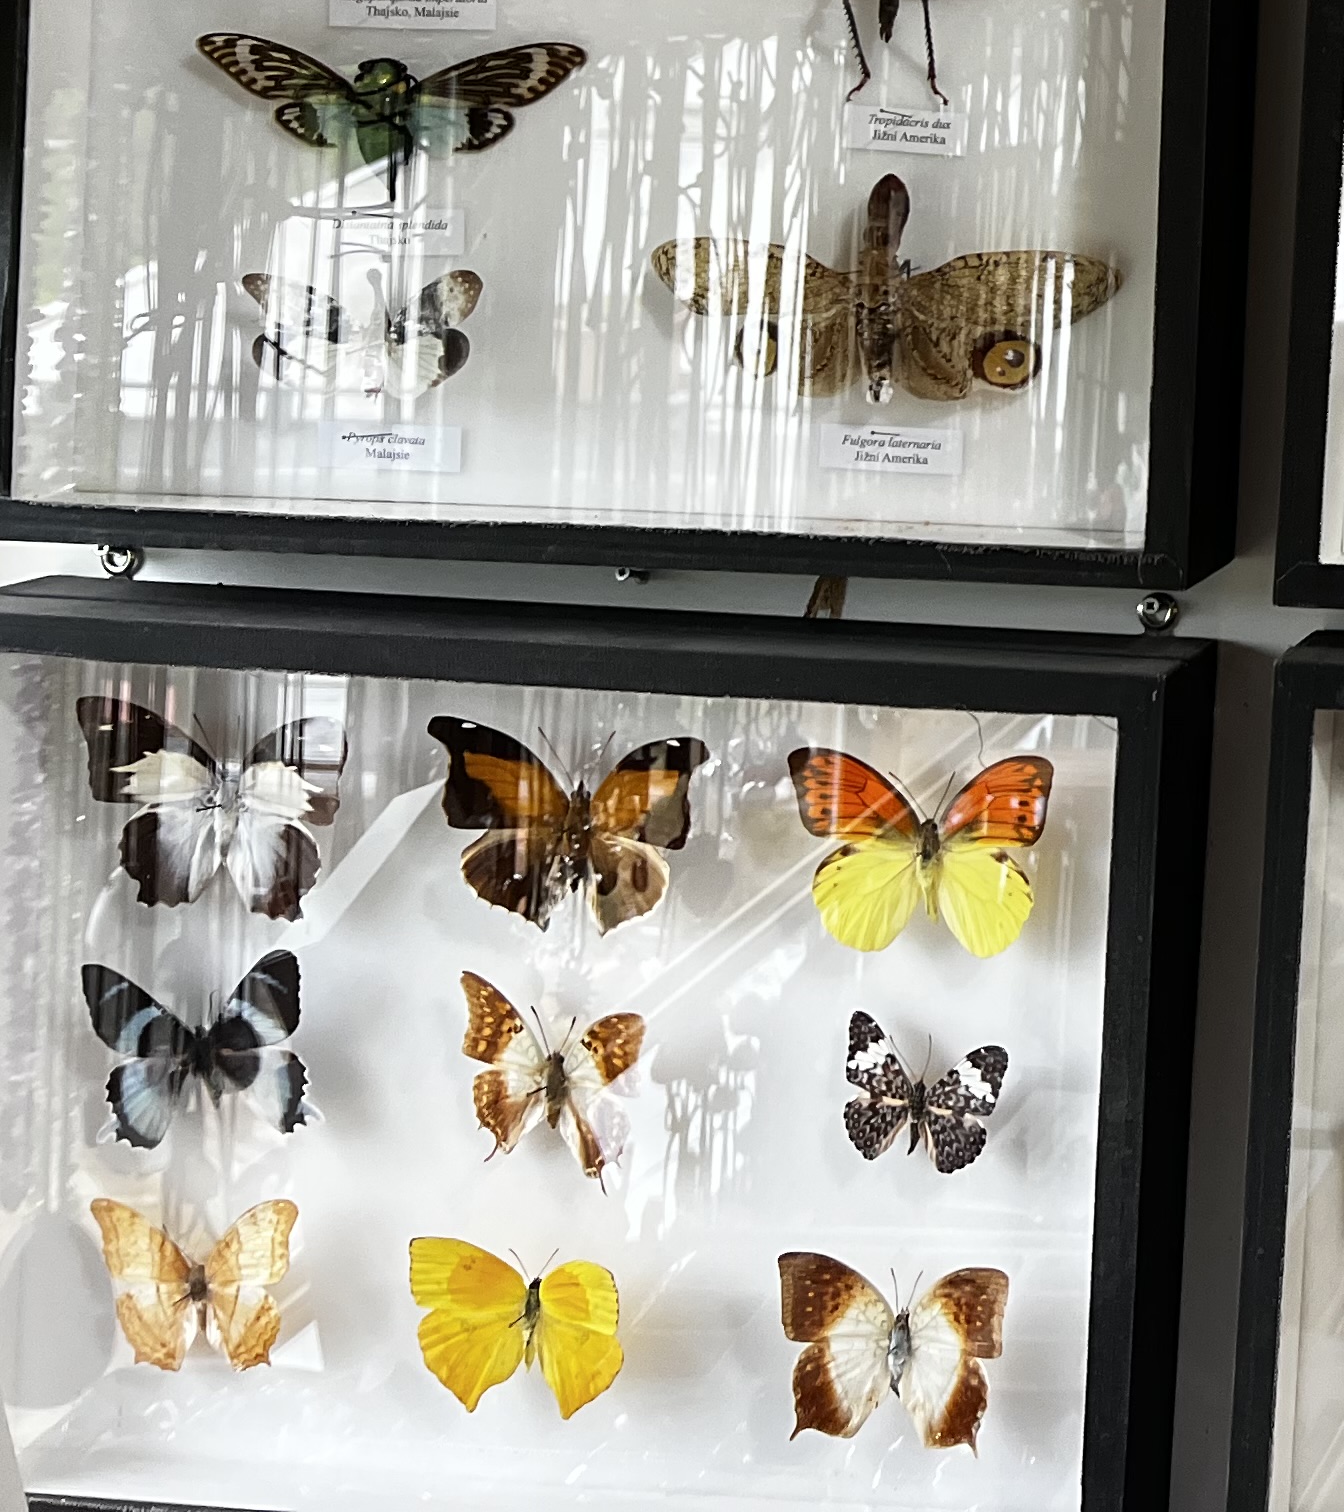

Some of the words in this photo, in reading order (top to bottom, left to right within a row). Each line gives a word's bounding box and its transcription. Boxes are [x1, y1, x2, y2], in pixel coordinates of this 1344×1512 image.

[367, 5, 413, 20] Thajsko,
[414, 7, 461, 21] Malajsie
[932, 118, 952, 130] dux
[870, 129, 897, 143] Jižní
[900, 132, 946, 146] Amerika
[397, 219, 448, 231] plendida
[842, 435, 886, 452] Fulgora
[365, 447, 411, 462] Malajsie
[854, 450, 880, 464] Jižní
[882, 453, 928, 466] Amerika
